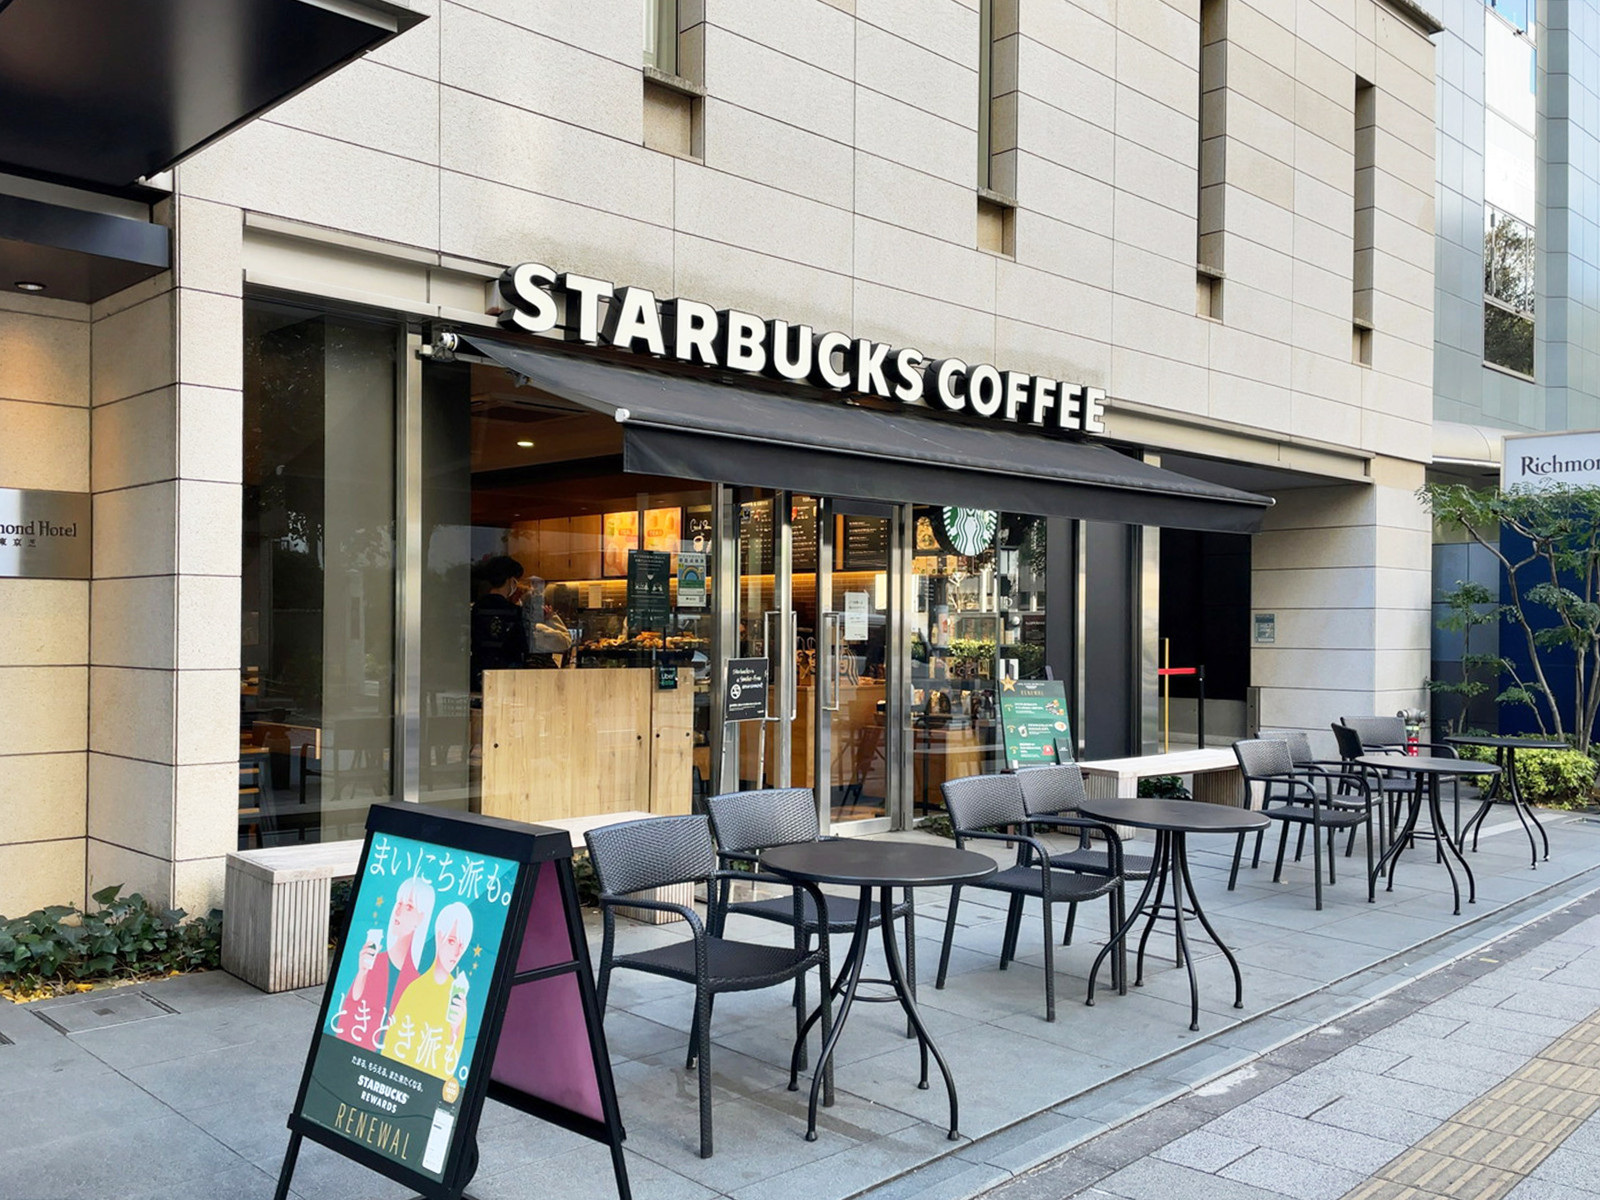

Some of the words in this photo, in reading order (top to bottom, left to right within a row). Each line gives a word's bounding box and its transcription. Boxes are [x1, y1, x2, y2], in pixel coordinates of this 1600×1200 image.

[508, 262, 925, 402] STARBUCKS
[935, 358, 1106, 433] COFFEE
[38, 521, 77, 537] Hotel
[369, 837, 511, 906] まいにち派も。
[330, 993, 469, 1081] ときどき派も。
[357, 1074, 409, 1105] STARBUCKS
[360, 1090, 398, 1114] REWARDS
[334, 1102, 410, 1160] RENEWAL
